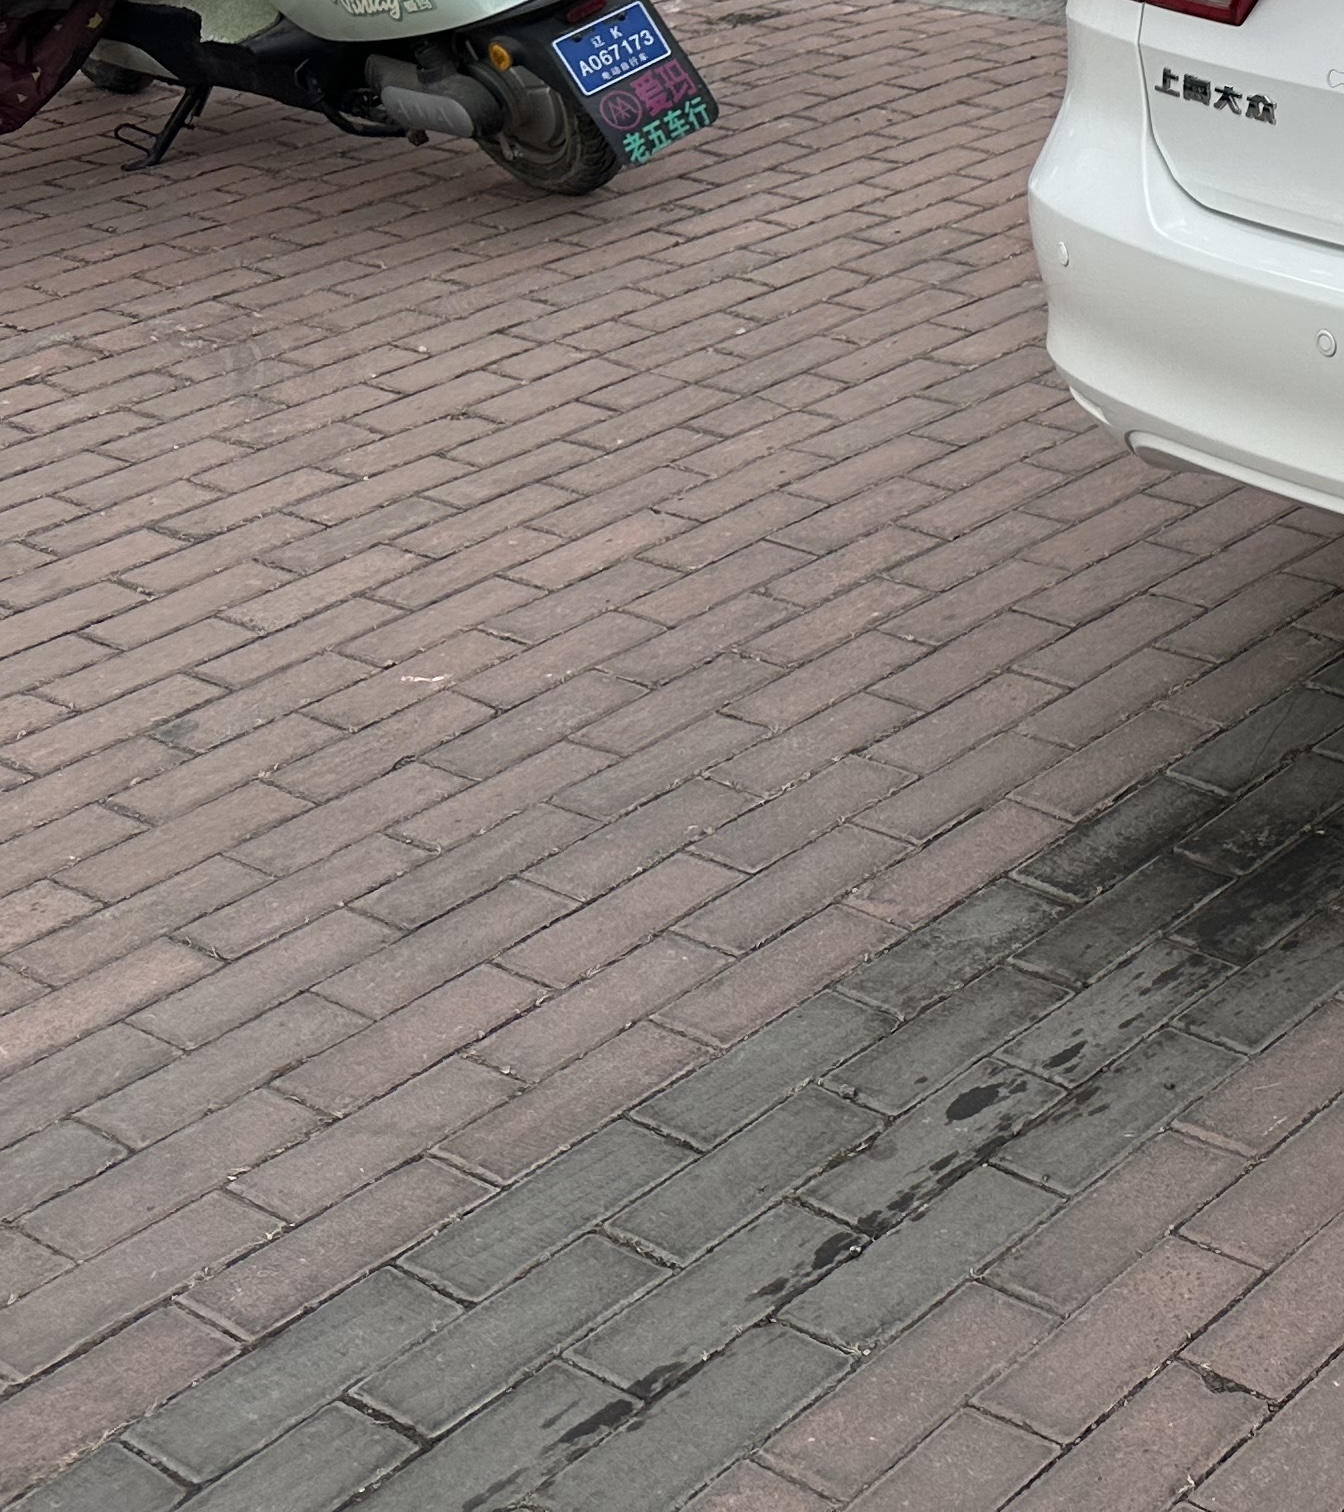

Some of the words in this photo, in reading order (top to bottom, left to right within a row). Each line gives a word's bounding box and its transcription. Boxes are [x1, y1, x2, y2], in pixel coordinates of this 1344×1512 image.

[578, 29, 655, 78] A067173
[591, 35, 606, 49] 辽
[610, 26, 623, 39] K
[630, 59, 698, 117] 爱玛
[623, 96, 711, 164] 老五车行
